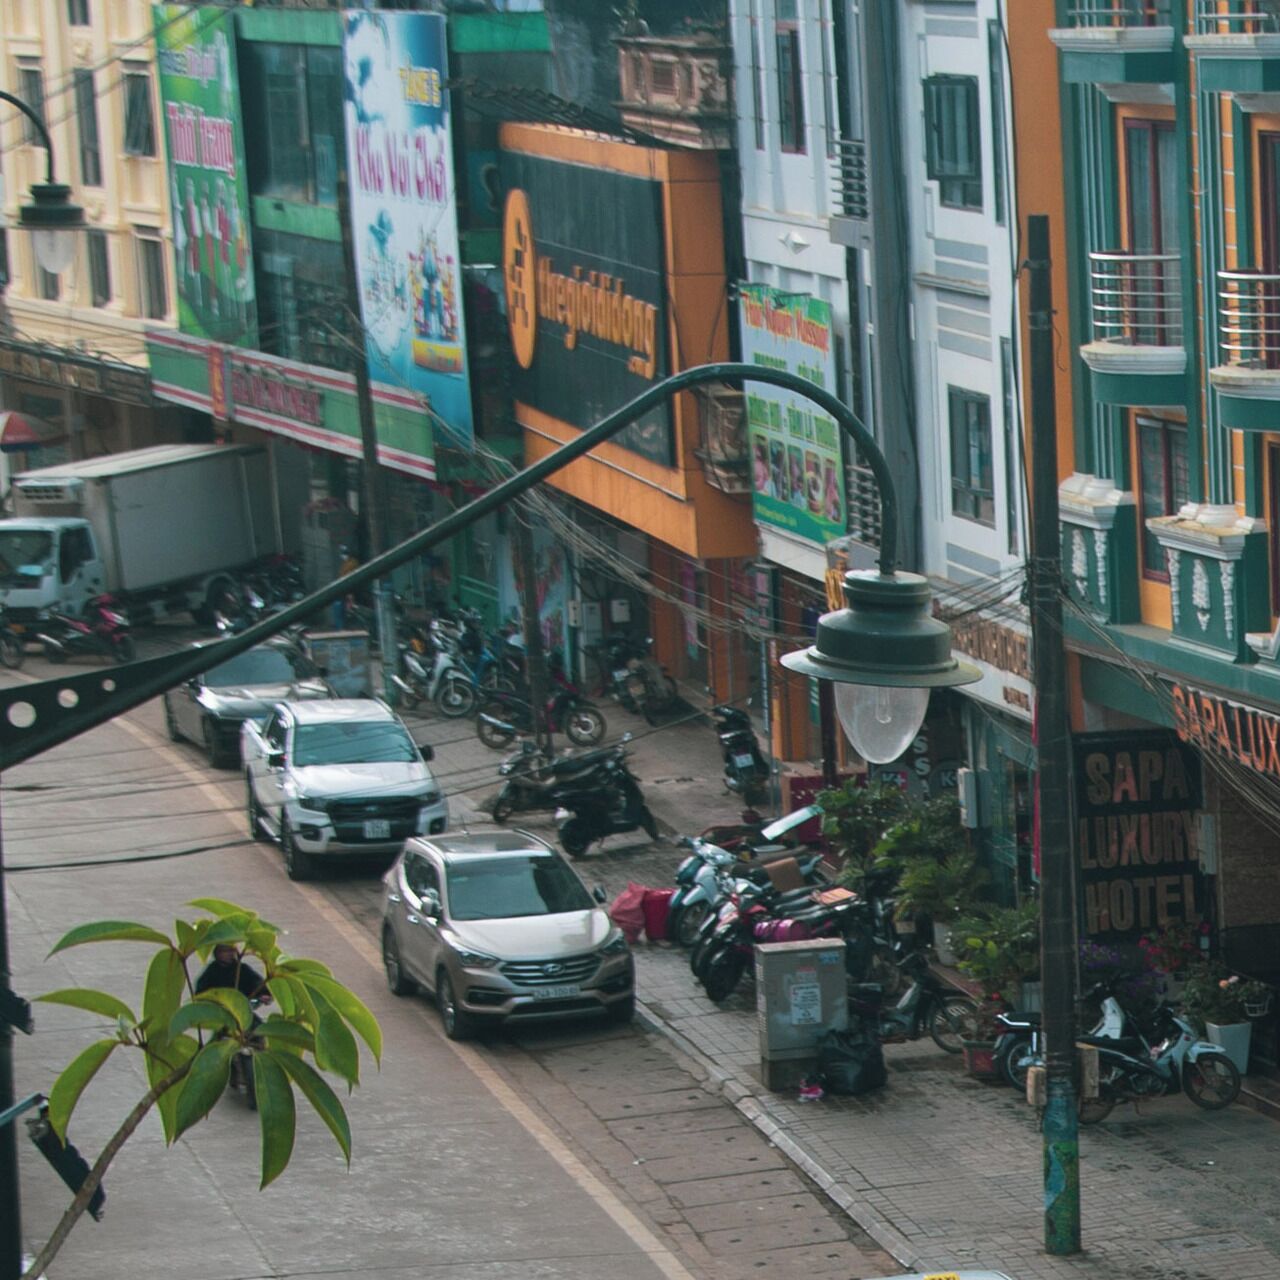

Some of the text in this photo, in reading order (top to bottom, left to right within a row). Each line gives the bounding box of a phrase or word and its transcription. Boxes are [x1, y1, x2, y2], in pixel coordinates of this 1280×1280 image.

[1172, 683, 1233, 760] SAPA
[1085, 751, 1189, 805] SAPA
[1079, 809, 1203, 869] LUXURY
[1086, 874, 1201, 934] HOTEL
